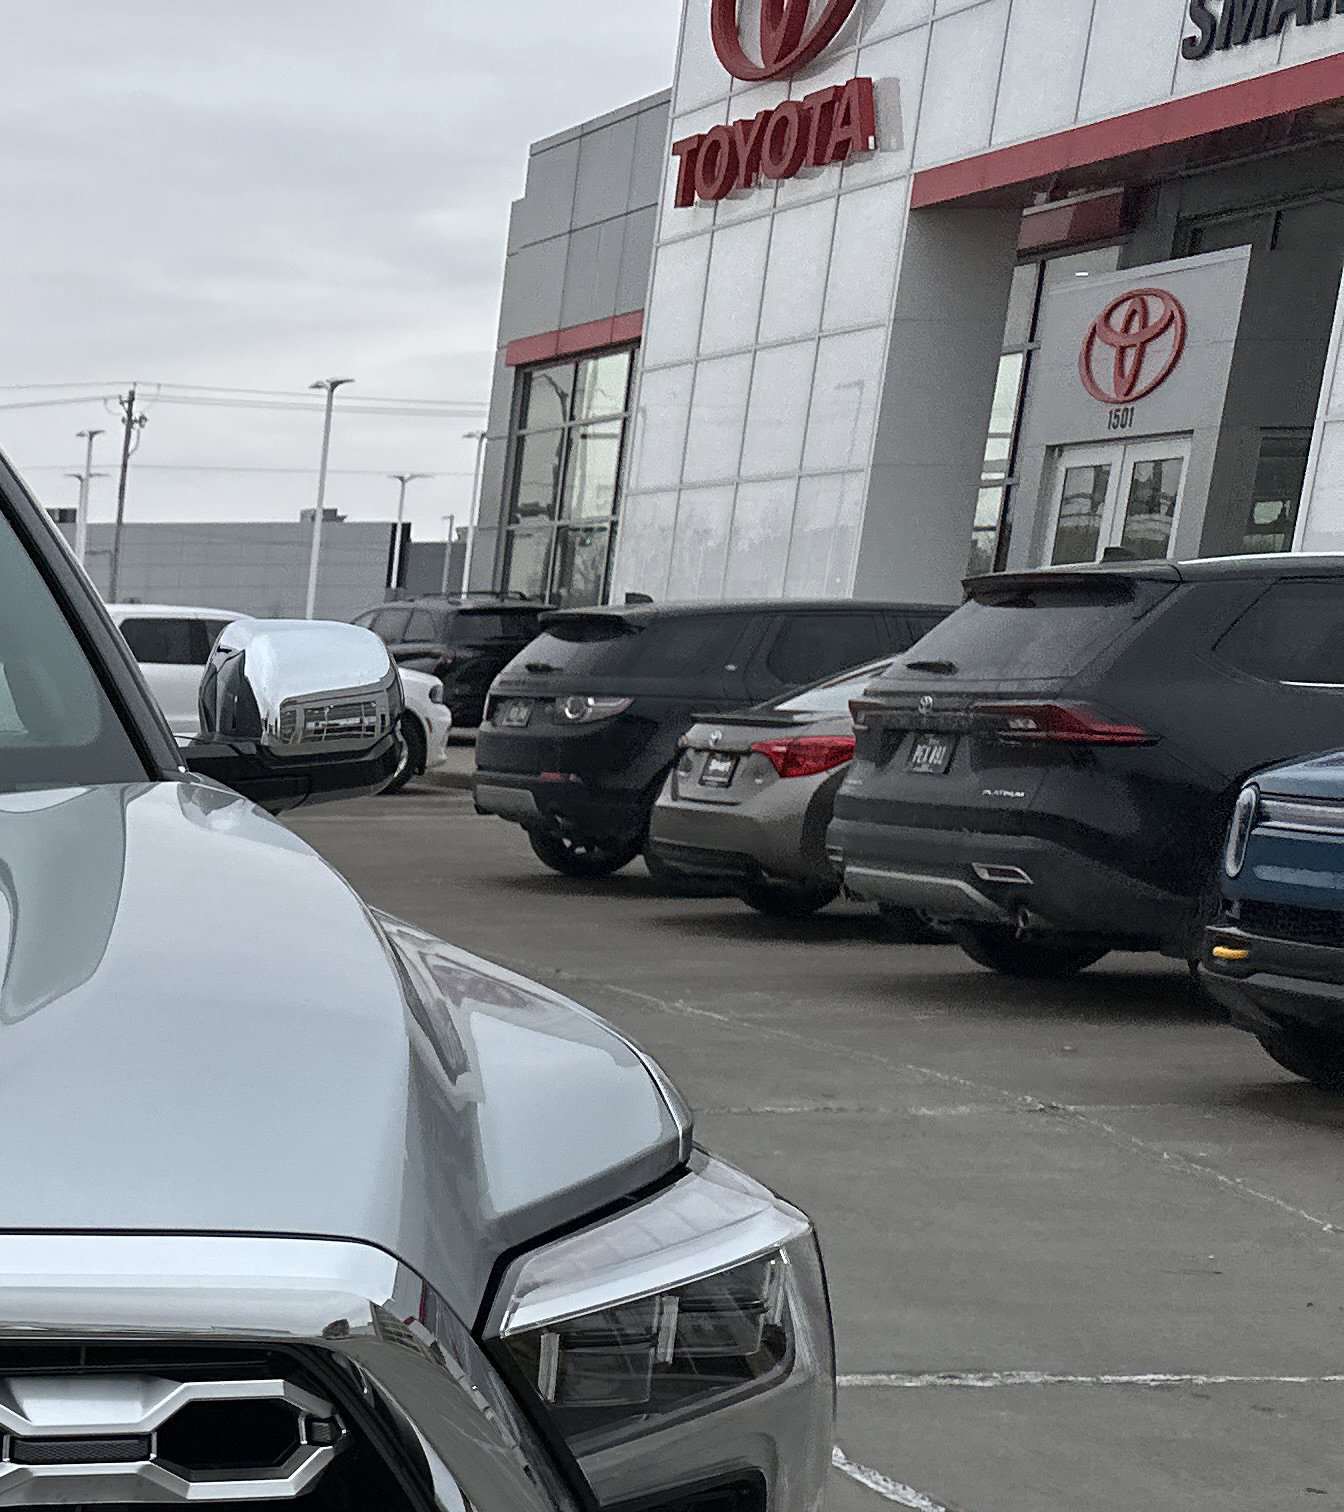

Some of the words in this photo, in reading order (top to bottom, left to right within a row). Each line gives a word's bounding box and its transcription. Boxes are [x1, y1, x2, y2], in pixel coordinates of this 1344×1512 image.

[673, 77, 878, 208] TOYOTA
[1107, 405, 1135, 430] 1501
[982, 788, 1025, 798] PLATINUM
